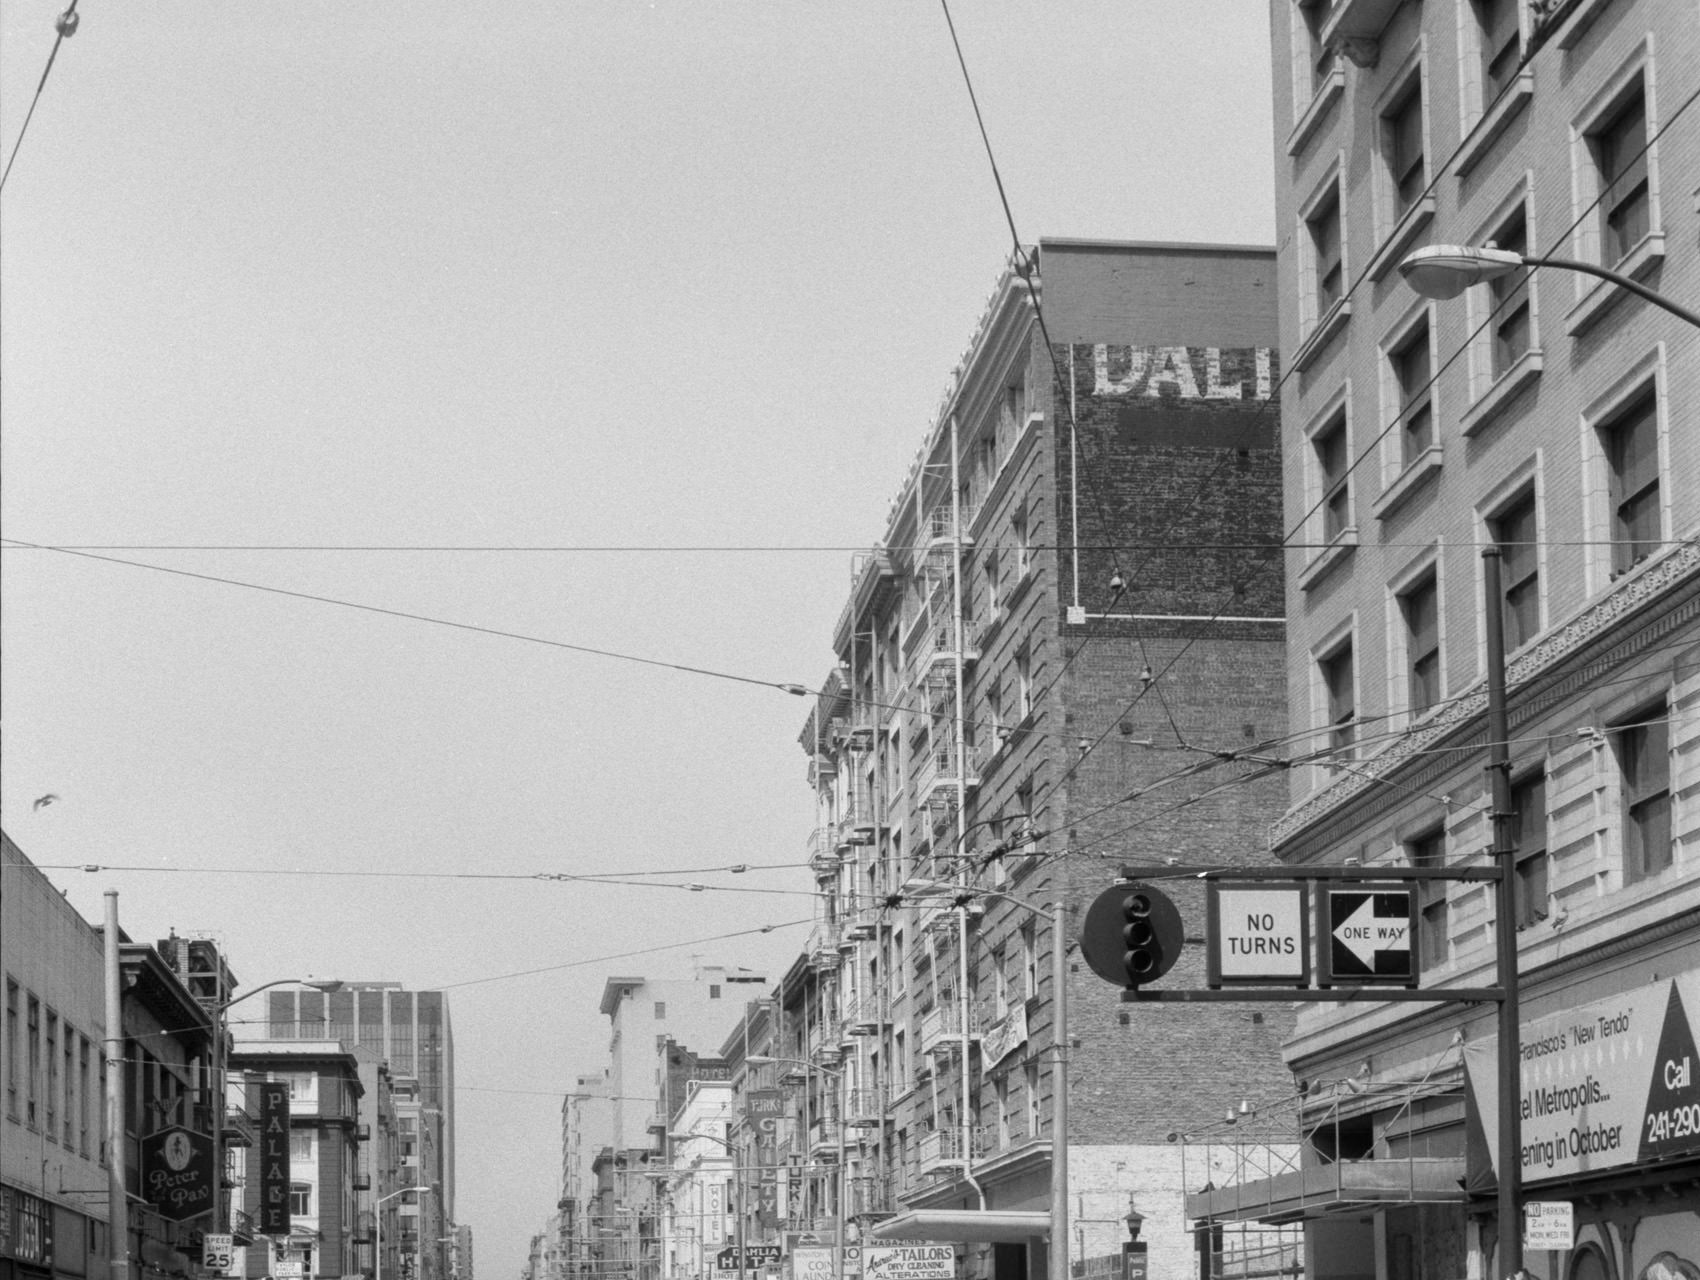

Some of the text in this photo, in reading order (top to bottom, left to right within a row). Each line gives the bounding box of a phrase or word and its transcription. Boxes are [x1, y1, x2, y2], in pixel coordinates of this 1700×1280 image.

[1247, 913, 1275, 932] NO
[1343, 927, 1405, 940] ONE WAY
[1227, 936, 1296, 955] TURNS
[1663, 1055, 1691, 1091] Call
[1535, 1074, 1611, 1117] Metropolis...
[1520, 1122, 1623, 1169] ening in October
[150, 1169, 199, 1191] Peter
[170, 1184, 209, 1208] Pan
[1528, 1203, 1571, 1217] NO PARKING
[205, 1236, 231, 1244] SPEED
[870, 1238, 927, 1247] MAGAZINES
[205, 1253, 230, 1268] 25
[900, 1247, 953, 1262] TAILORS
[888, 1261, 945, 1271] DRY CLEANING
[875, 1270, 951, 1280] ALTERATIONS
